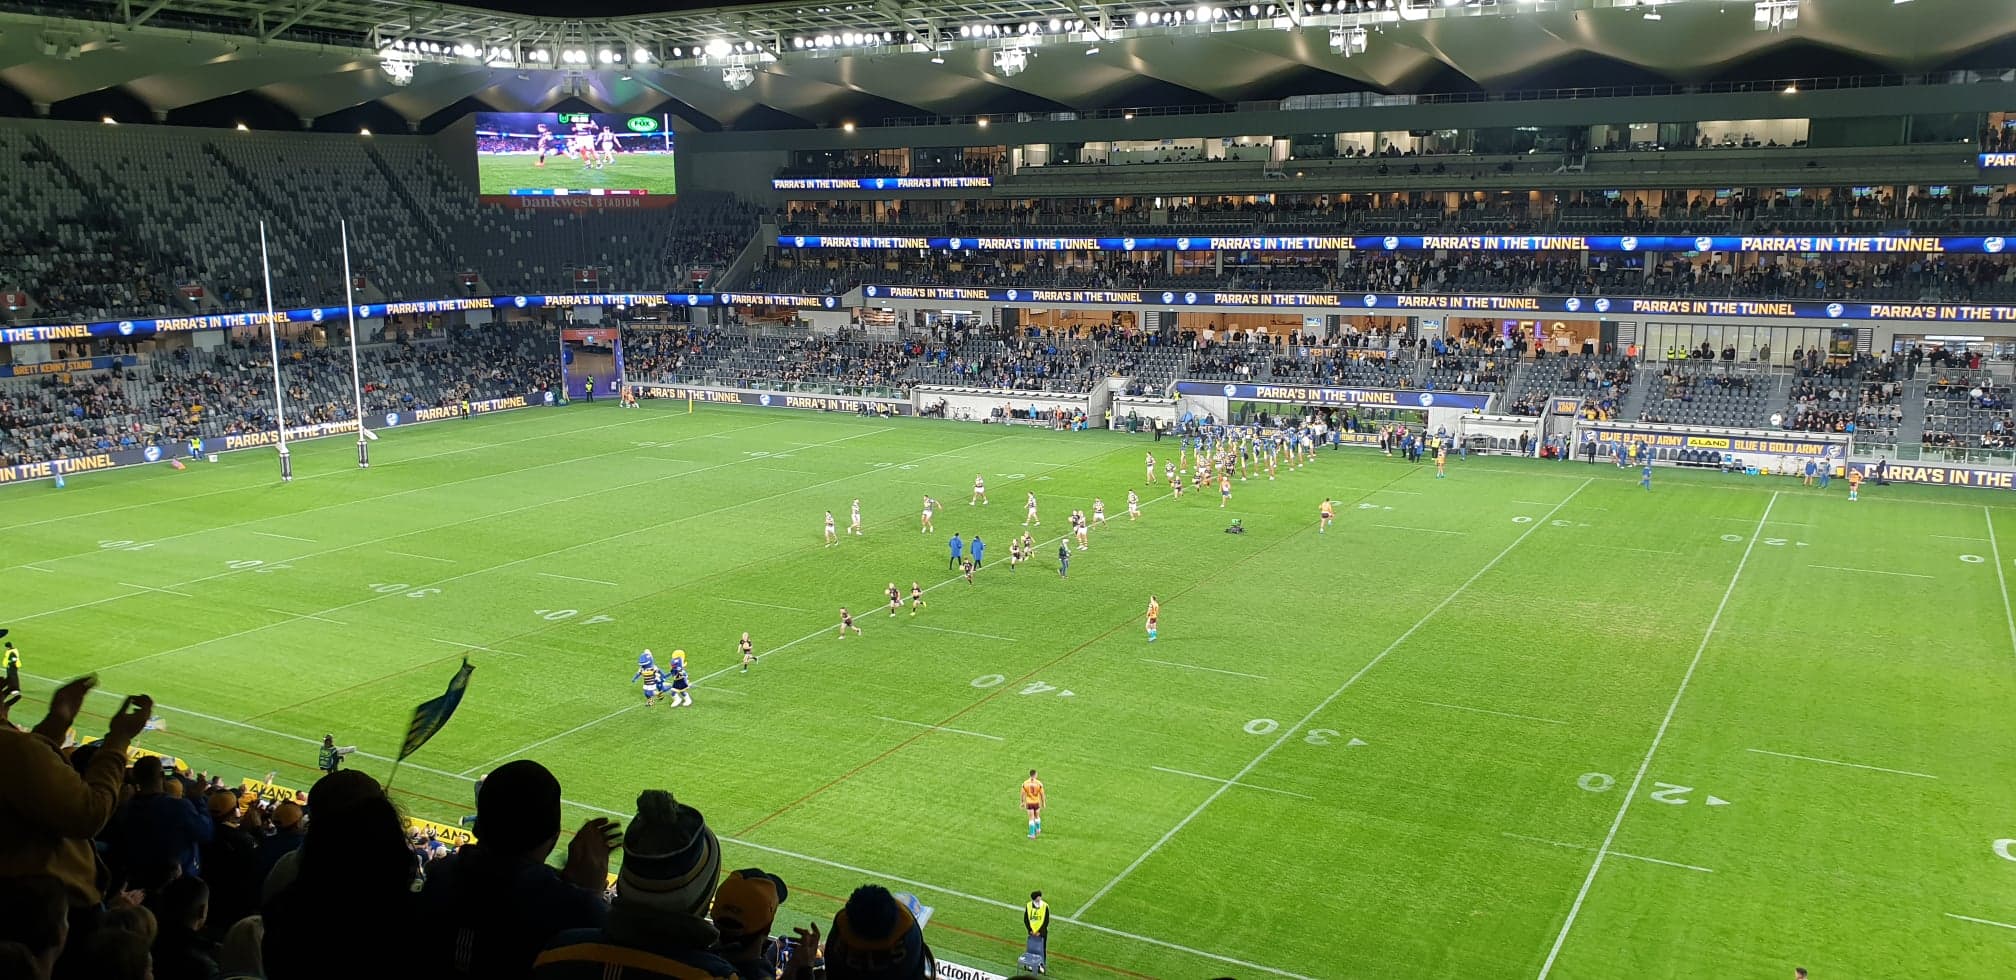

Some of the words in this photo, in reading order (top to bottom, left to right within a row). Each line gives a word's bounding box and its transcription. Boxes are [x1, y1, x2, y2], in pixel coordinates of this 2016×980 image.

[1984, 154, 2016, 166] PAR
[774, 180, 806, 188] PARRA'S
[806, 180, 814, 188] IN
[816, 180, 830, 188] THE
[831, 180, 860, 188] TUNNEL
[898, 178, 931, 188] PARRA'S
[932, 178, 940, 187] IN
[942, 178, 958, 187] THE
[958, 178, 991, 187] TUNNEL
[522, 196, 593, 208] bankwest
[597, 199, 640, 208] STADIUM
[820, 238, 858, 248] PARRA'S
[861, 238, 870, 248] IN
[873, 238, 891, 248] THE
[893, 238, 930, 248] TUNNEL
[978, 238, 1021, 250] PARRA'S
[1024, 239, 1034, 249] IN
[1036, 238, 1056, 249] THE
[1058, 238, 1100, 250] TUNNEL
[1211, 238, 1260, 250] PARRA'S
[1264, 238, 1276, 249] IN
[1280, 238, 1304, 249] THE
[1306, 238, 1356, 249] TUNNEL
[1422, 238, 1480, 250] PARRA'S
[1484, 238, 1498, 249] IN
[1502, 238, 1529, 249] THE
[1532, 238, 1589, 250] TUNNEL
[1741, 238, 1810, 251] PARRA'S
[1816, 238, 1834, 250] IN
[1838, 238, 1870, 250] THE
[1874, 238, 1944, 251] TUNNEL
[890, 287, 925, 297] PARRA'S
[927, 288, 936, 297] IN
[939, 288, 954, 298] THE
[955, 289, 989, 299] TUNNEL
[1033, 291, 1071, 301] PARRA'S
[1074, 292, 1083, 302] IN
[1085, 292, 1104, 302] THE
[1105, 292, 1142, 302] TUNNEL
[387, 301, 425, 314] PARRA'S
[427, 300, 436, 312] IN
[438, 300, 455, 312] THE
[457, 298, 494, 310] TUNNEL
[545, 296, 590, 306] PARRA'S
[592, 296, 602, 305] IN
[604, 295, 626, 305] THE
[629, 294, 668, 305] TUNNEL
[732, 294, 763, 304] PARRA'S
[764, 295, 773, 304] IN
[775, 296, 788, 305] THE
[790, 296, 822, 307] TUNNEL
[1214, 294, 1258, 304] PARRA'S
[1260, 294, 1272, 304] IN
[1274, 294, 1295, 305] THE
[1298, 295, 1341, 306] TUNNEL
[1398, 296, 1447, 307] PARRA'S
[1450, 296, 1462, 307] IN
[1465, 298, 1489, 308] THE
[1492, 298, 1540, 309] TUNNEL
[1634, 300, 1689, 312] PARRA'S
[1692, 301, 1706, 312] IN
[1710, 302, 1737, 314] THE
[1740, 303, 1796, 316] TUNNEL
[1871, 306, 1936, 318] PARRA'S
[1941, 306, 1958, 318] IN
[1963, 308, 1993, 319] THE
[1996, 308, 2016, 320] TU
[156, 318, 206, 332] PARRA'S
[209, 316, 222, 328] IN
[224, 314, 246, 327] THE
[250, 312, 290, 325] TUNNEL
[8, 328, 34, 342] THE
[38, 324, 92, 340] TUNNEL
[40, 362, 66, 374] KENNY
[68, 360, 92, 372] STAND
[676, 389, 686, 399] IN
[687, 390, 704, 400] THE
[706, 391, 741, 402] TUNNEL
[1256, 386, 1306, 399] PARRA'S
[1308, 388, 1322, 400] IN
[1324, 389, 1347, 401] THE
[1350, 390, 1397, 404] TUNNEL
[416, 406, 458, 420] PARRA'S
[472, 402, 490, 412] THE
[492, 396, 527, 410] TUNNEL
[786, 397, 826, 408] PARRA'S
[828, 399, 838, 410] IN
[840, 400, 858, 411] THE
[226, 431, 278, 449] PARRA'S
[296, 426, 320, 438] THE
[323, 420, 359, 434] TUNNE
[1657, 435, 1682, 446] ARMY
[1690, 438, 1727, 447] ALAND
[1734, 439, 1758, 450] BLUE
[1769, 442, 1794, 452] GOLD
[1797, 444, 1824, 455] ARMY
[0, 467, 16, 482] IN
[22, 462, 52, 477] THE
[55, 454, 114, 474] TUNNEL
[1950, 468, 1968, 484] IN
[1974, 470, 2012, 487] THE
